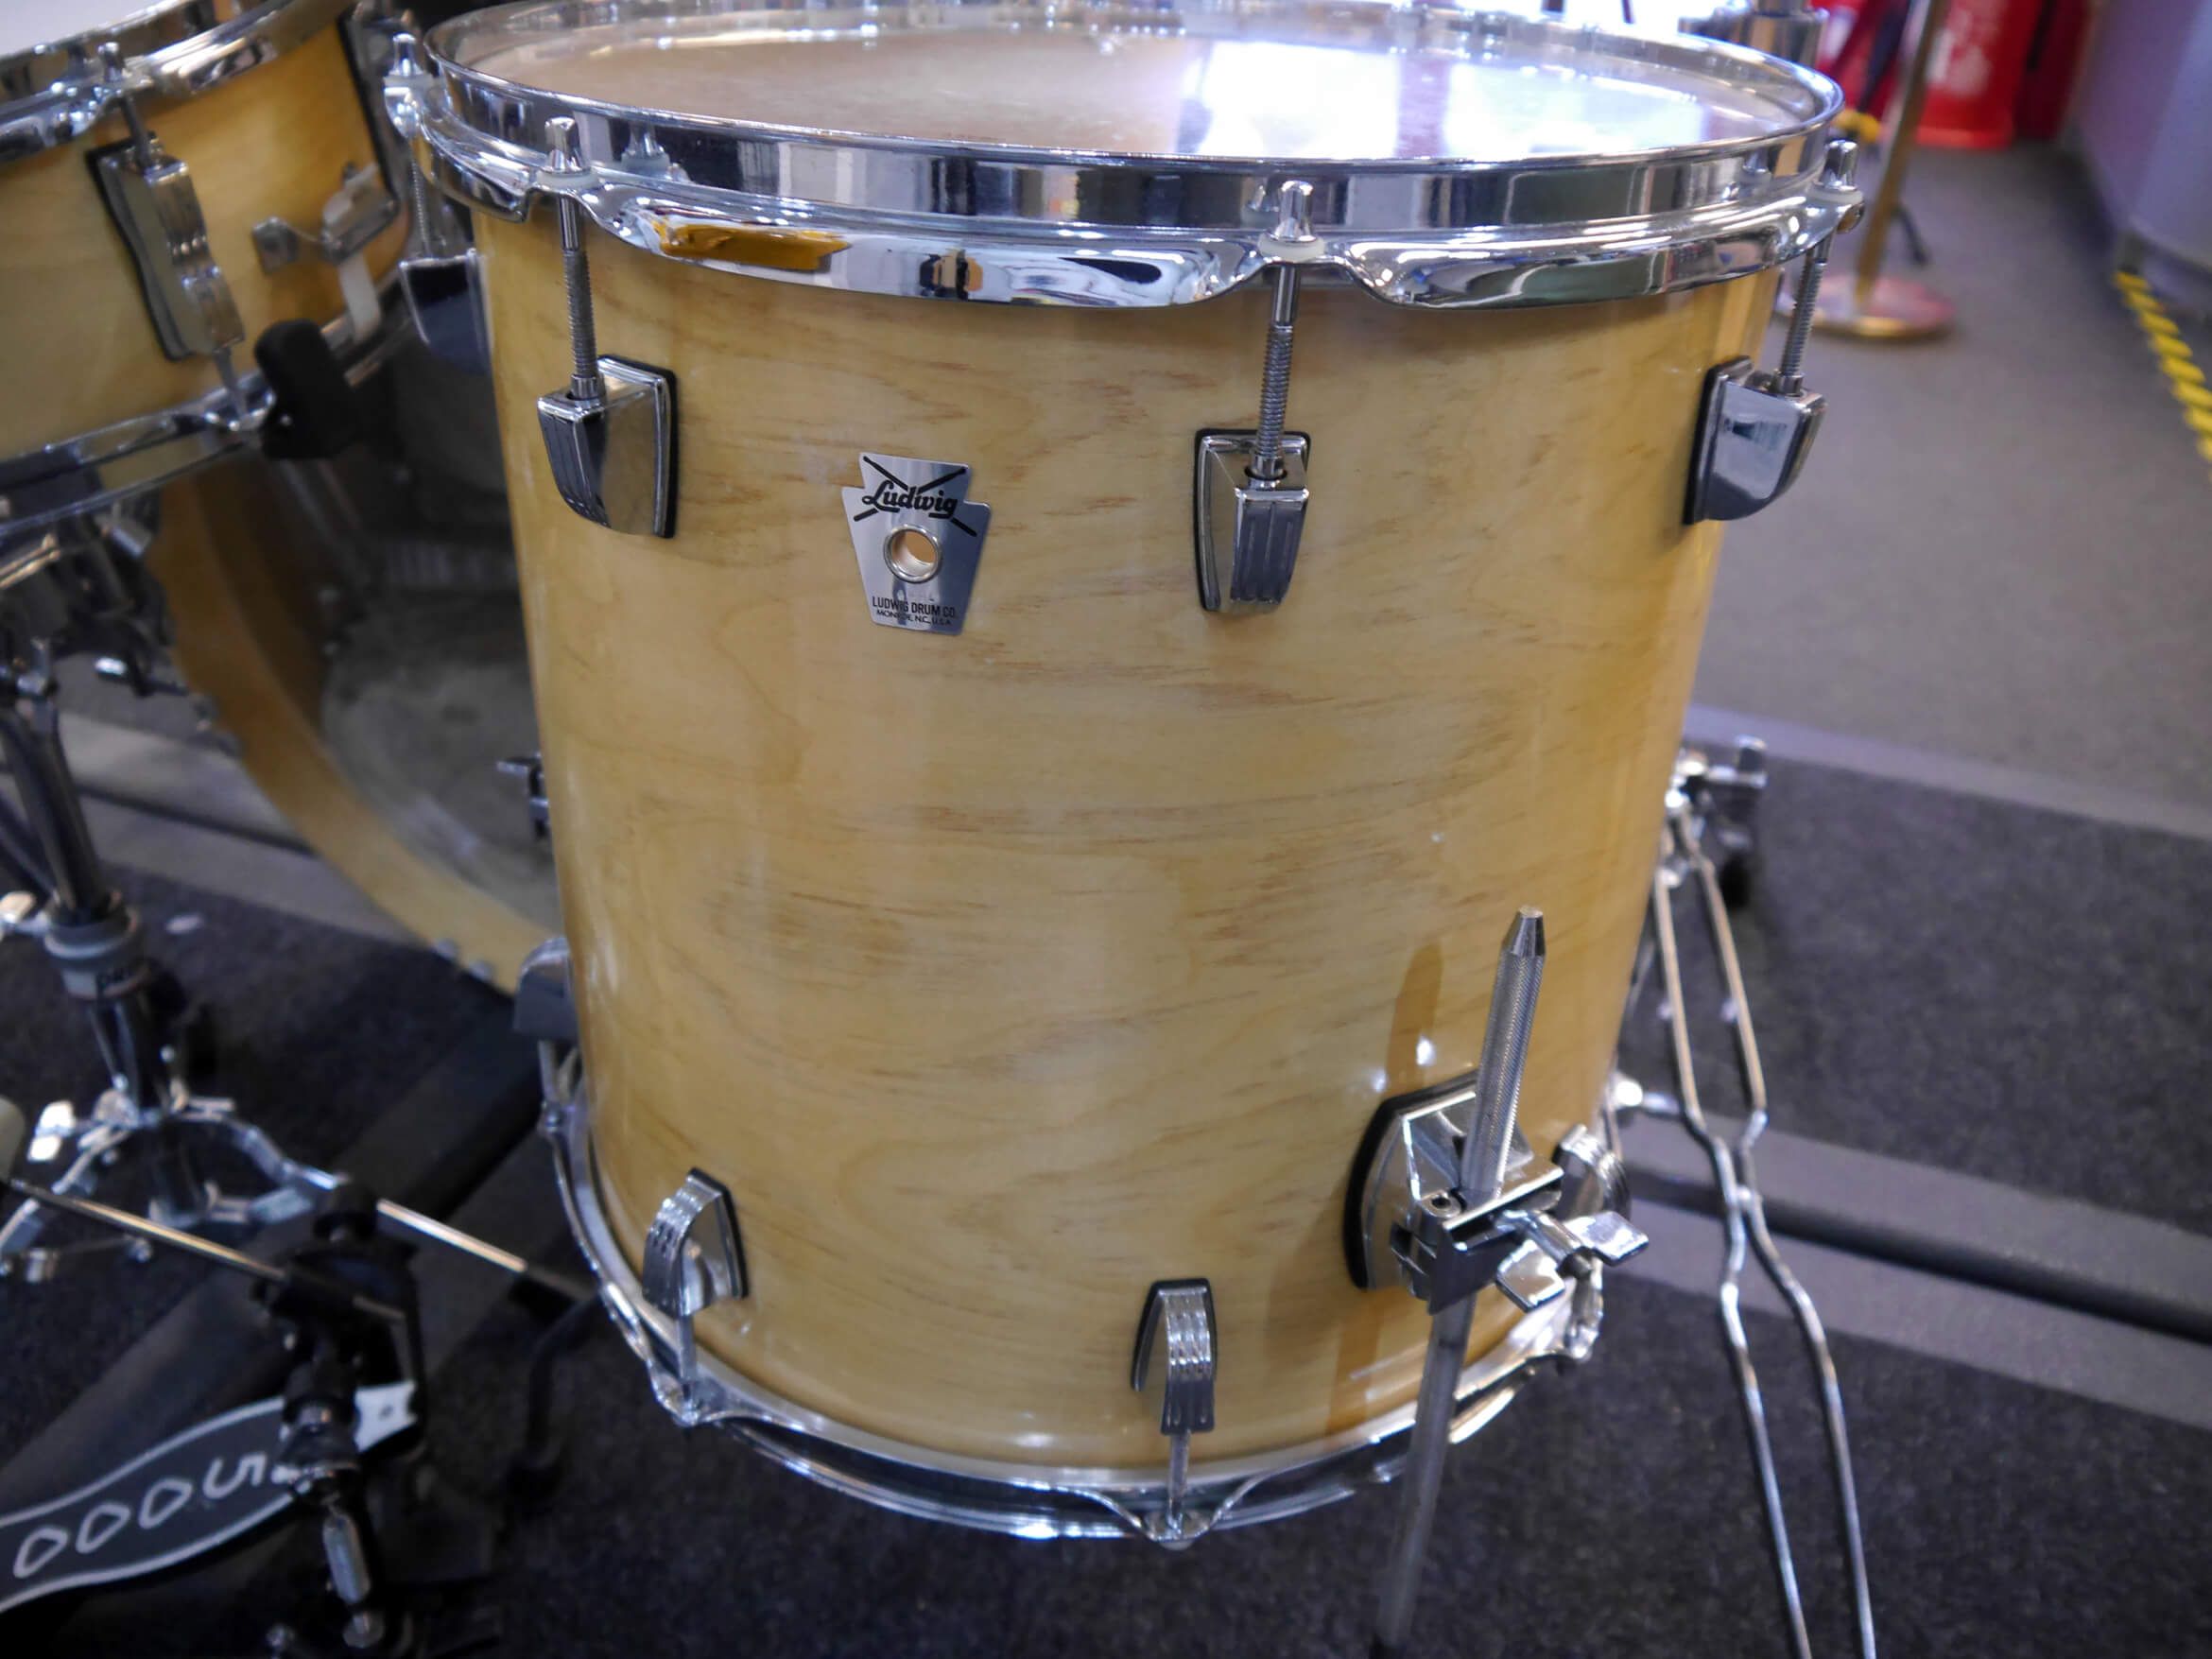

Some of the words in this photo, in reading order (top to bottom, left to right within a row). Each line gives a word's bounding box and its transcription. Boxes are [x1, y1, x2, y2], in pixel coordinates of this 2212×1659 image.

[862, 479, 958, 519] Ludwig
[872, 596, 908, 613] LUDWIG
[910, 601, 942, 618] DRUM
[12, 1451, 267, 1579] 5000
